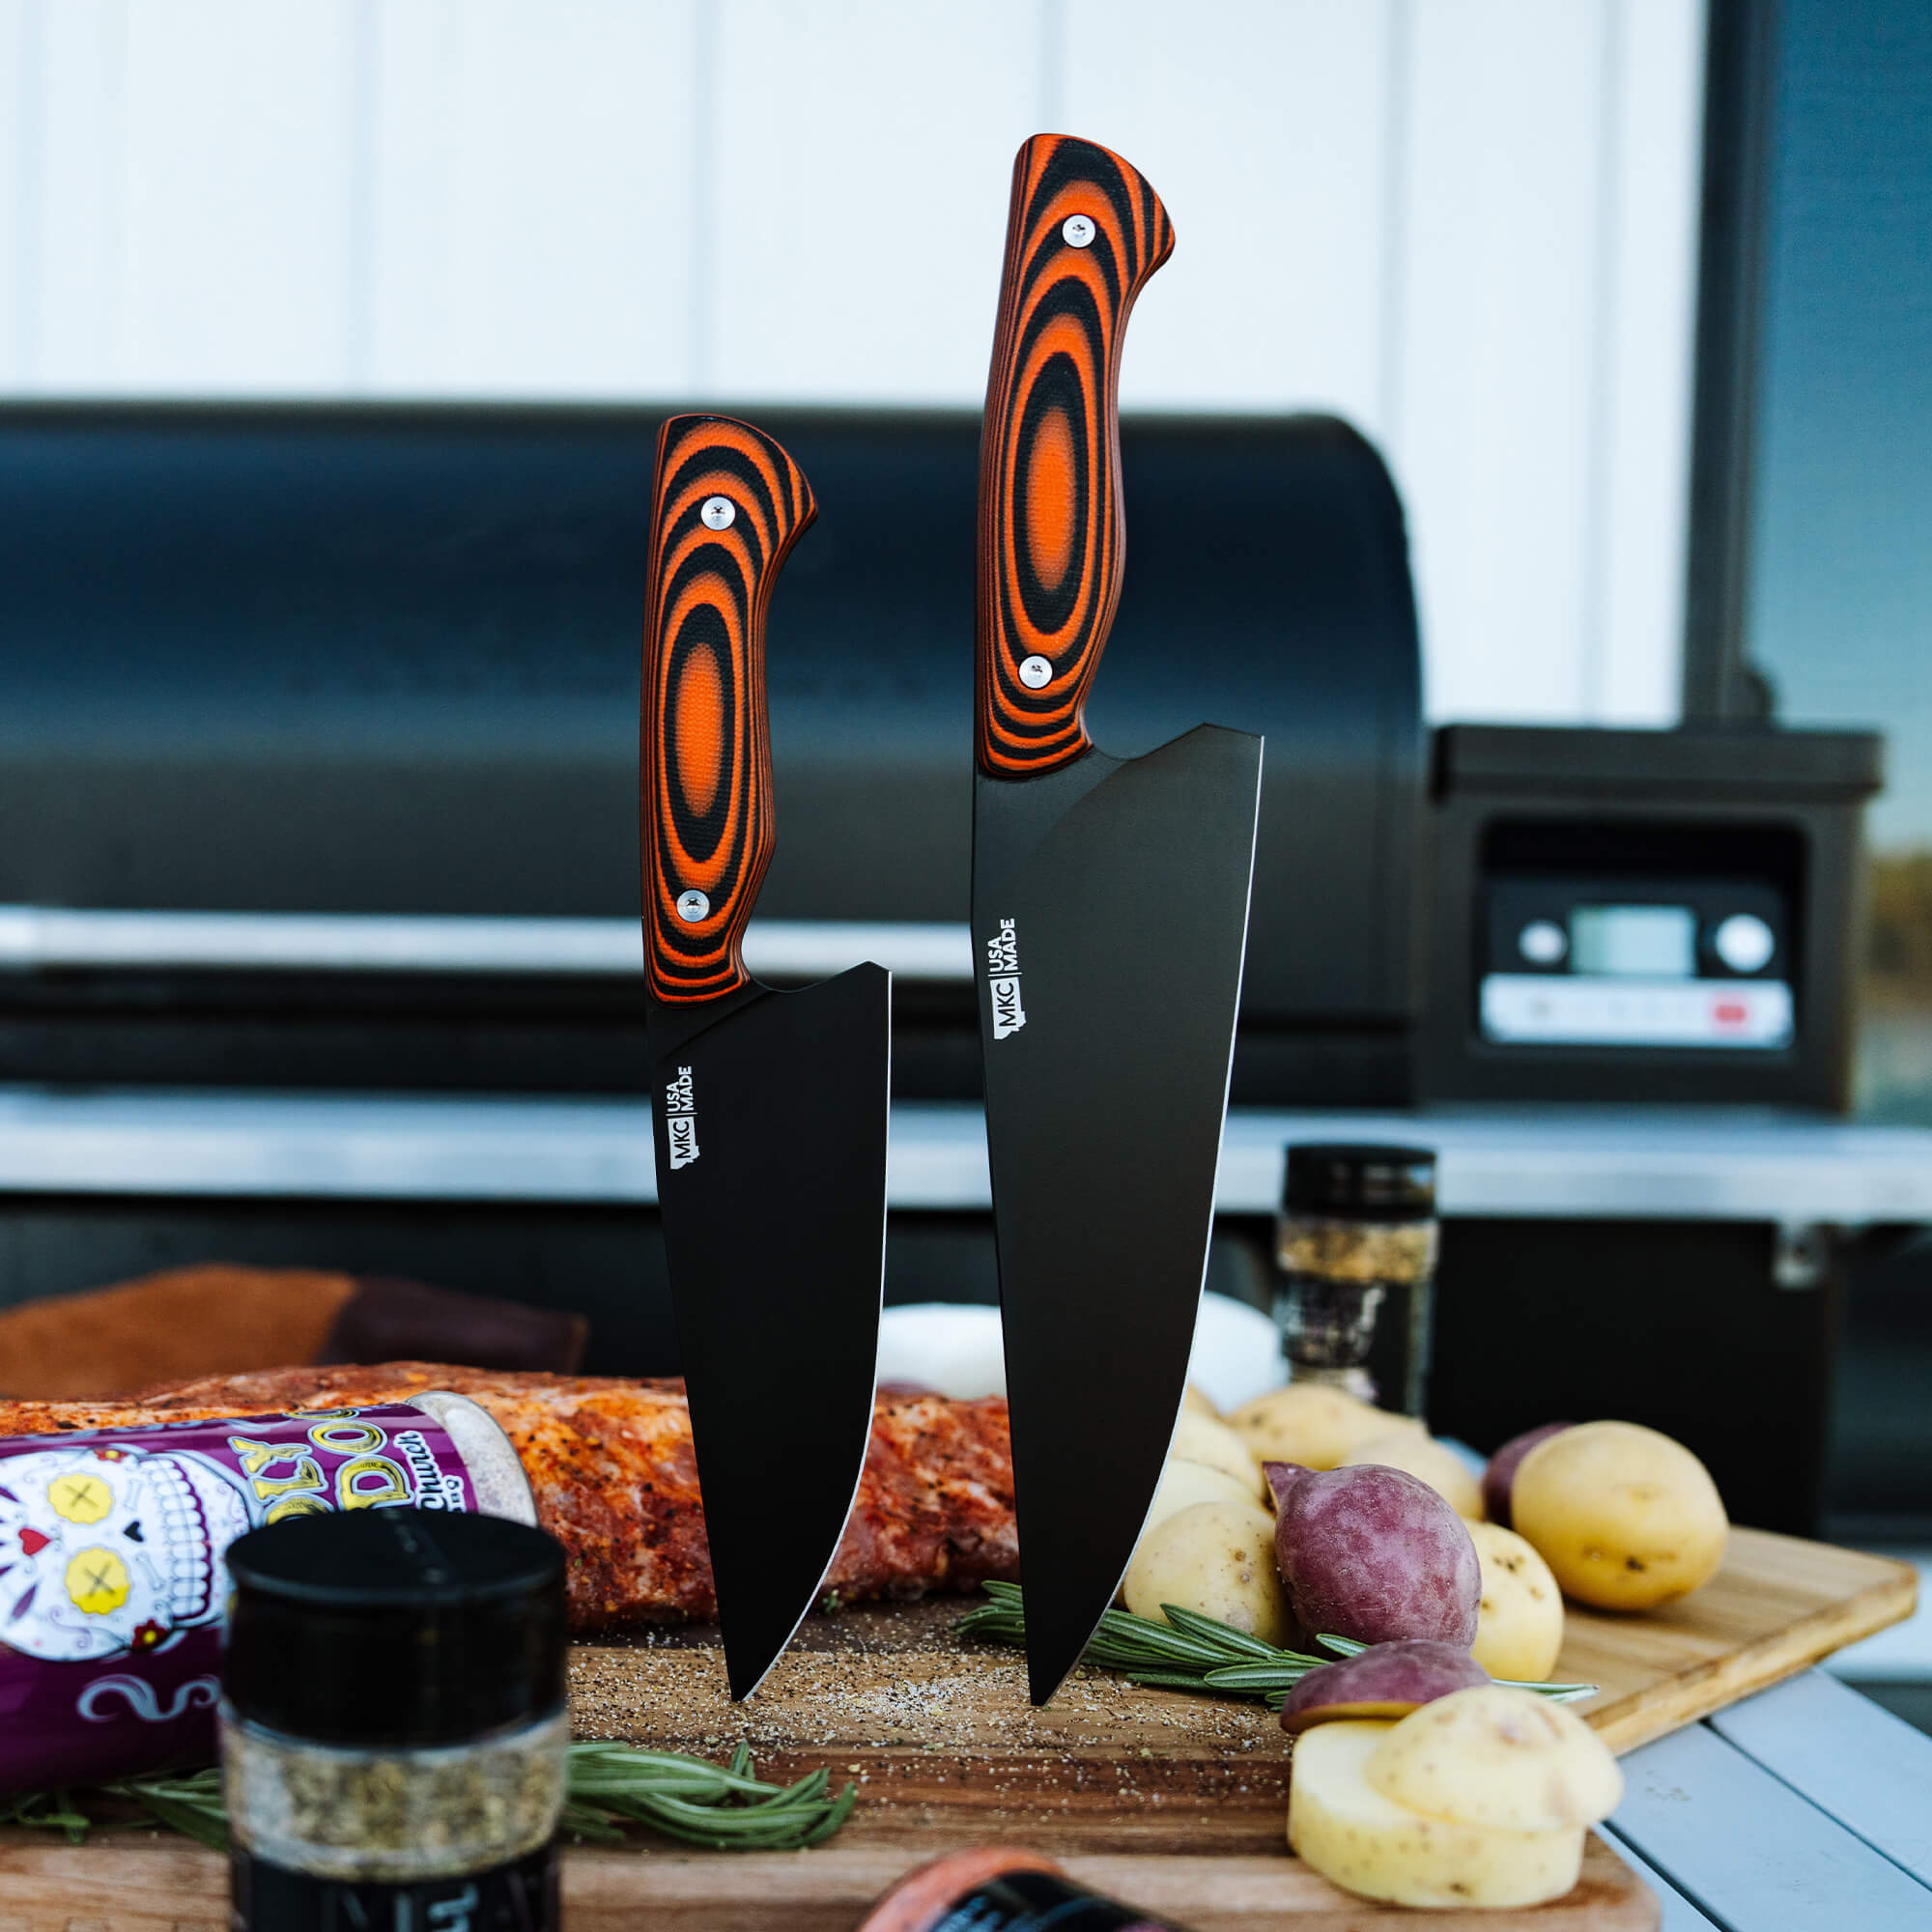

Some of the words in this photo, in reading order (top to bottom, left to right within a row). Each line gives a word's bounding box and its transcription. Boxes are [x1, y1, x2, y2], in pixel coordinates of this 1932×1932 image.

[987, 937, 1005, 973] USA
[1000, 918, 1019, 972] MADE
[996, 982, 1016, 1027] MKC
[666, 1081, 681, 1112] USA
[678, 1065, 695, 1111] MADE
[672, 1121, 692, 1159] MKC
